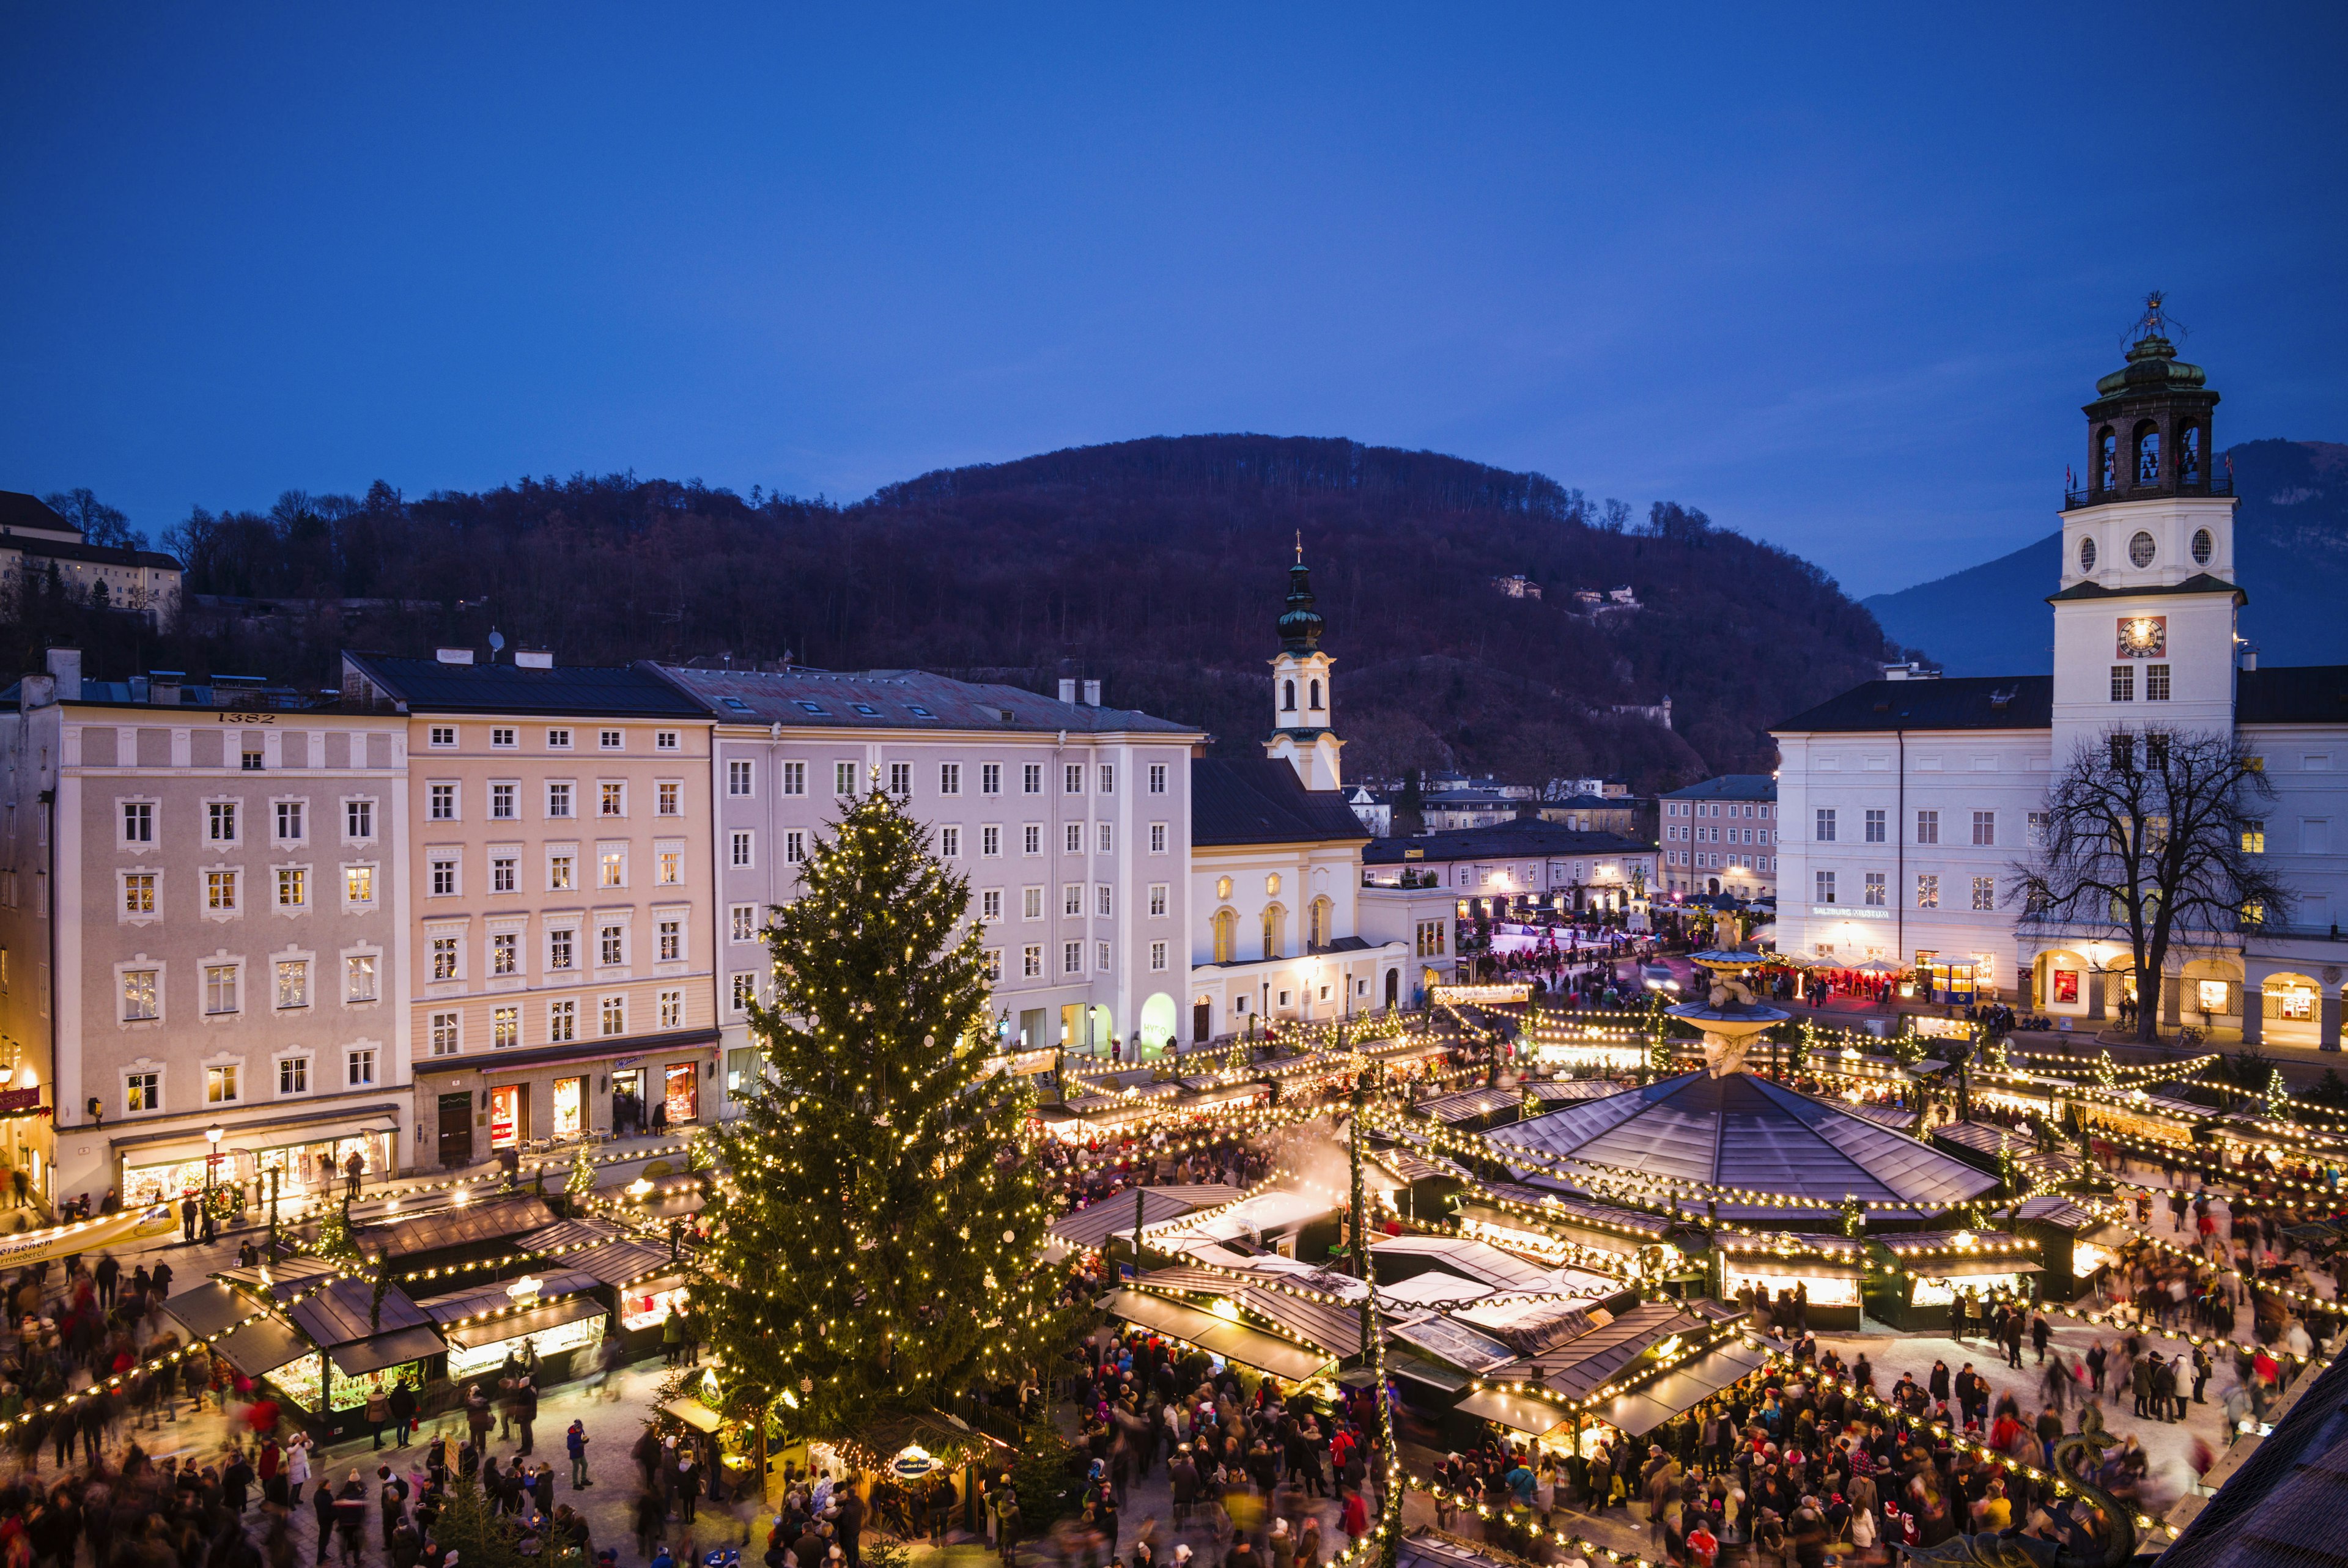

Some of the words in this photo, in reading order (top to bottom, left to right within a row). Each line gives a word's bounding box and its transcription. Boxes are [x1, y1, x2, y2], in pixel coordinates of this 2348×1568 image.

[218, 713, 275, 724] 1382
[1813, 907, 1851, 917] SALZBURG
[1852, 909, 1888, 919] MUSEUM
[0, 1239, 53, 1256] ersehen
